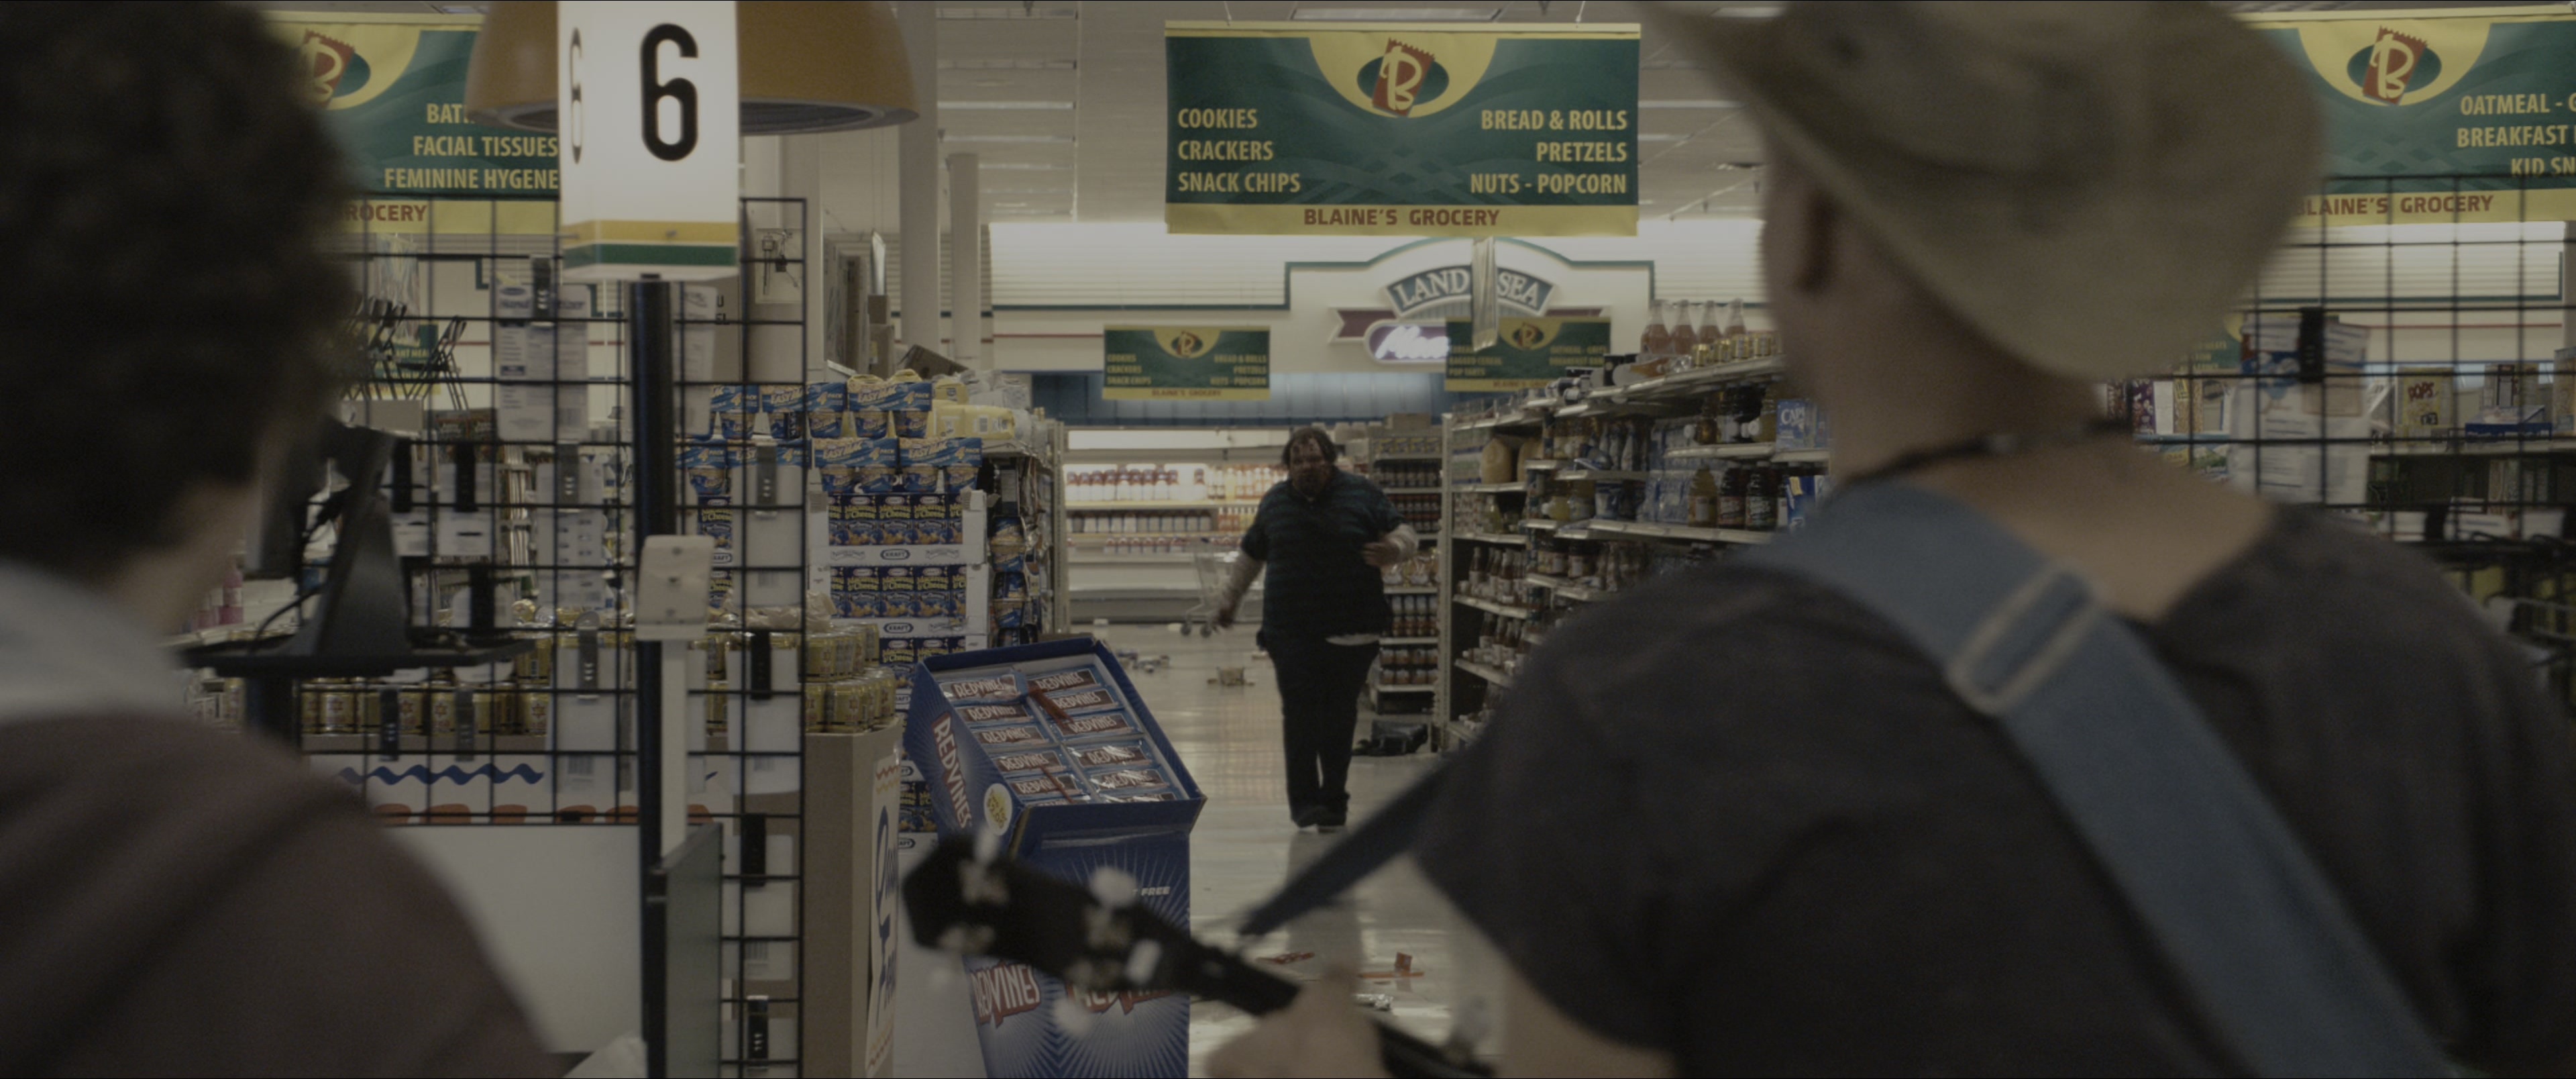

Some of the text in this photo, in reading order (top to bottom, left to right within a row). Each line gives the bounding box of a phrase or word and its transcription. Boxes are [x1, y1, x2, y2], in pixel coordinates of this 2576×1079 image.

[640, 23, 698, 161] 6
[427, 103, 475, 124] BAT
[2460, 93, 2550, 115] OATMEAL
[1177, 108, 1258, 130] COOKIES
[1481, 109, 1627, 131] BREAD & ROLLS
[413, 136, 558, 158] FACIAL TISSUES
[2457, 125, 2568, 148] BREAKFAST
[1177, 140, 1274, 162] CRACKERS
[1536, 142, 1627, 162] PRETZELS
[2511, 157, 2544, 177] KID
[384, 168, 559, 190] FEMININE HYGENE
[1177, 172, 1301, 195] SNACK CHIPS
[1470, 174, 1519, 195] NUTS
[1537, 174, 1627, 195] POPCORN
[338, 204, 428, 222] ROCERY
[2400, 195, 2494, 213] GROCERY
[1303, 209, 1500, 227] BLAINE'S GROCERY
[1394, 268, 1540, 309] LAND SEA
[1035, 672, 1084, 690] REDVINES
[1069, 715, 1118, 733] REDVINES
[932, 715, 973, 829] REDVINES
[1000, 753, 1049, 770] REDVINES
[1141, 886, 1171, 896] FREE
[970, 964, 1041, 1019] REDVINES
